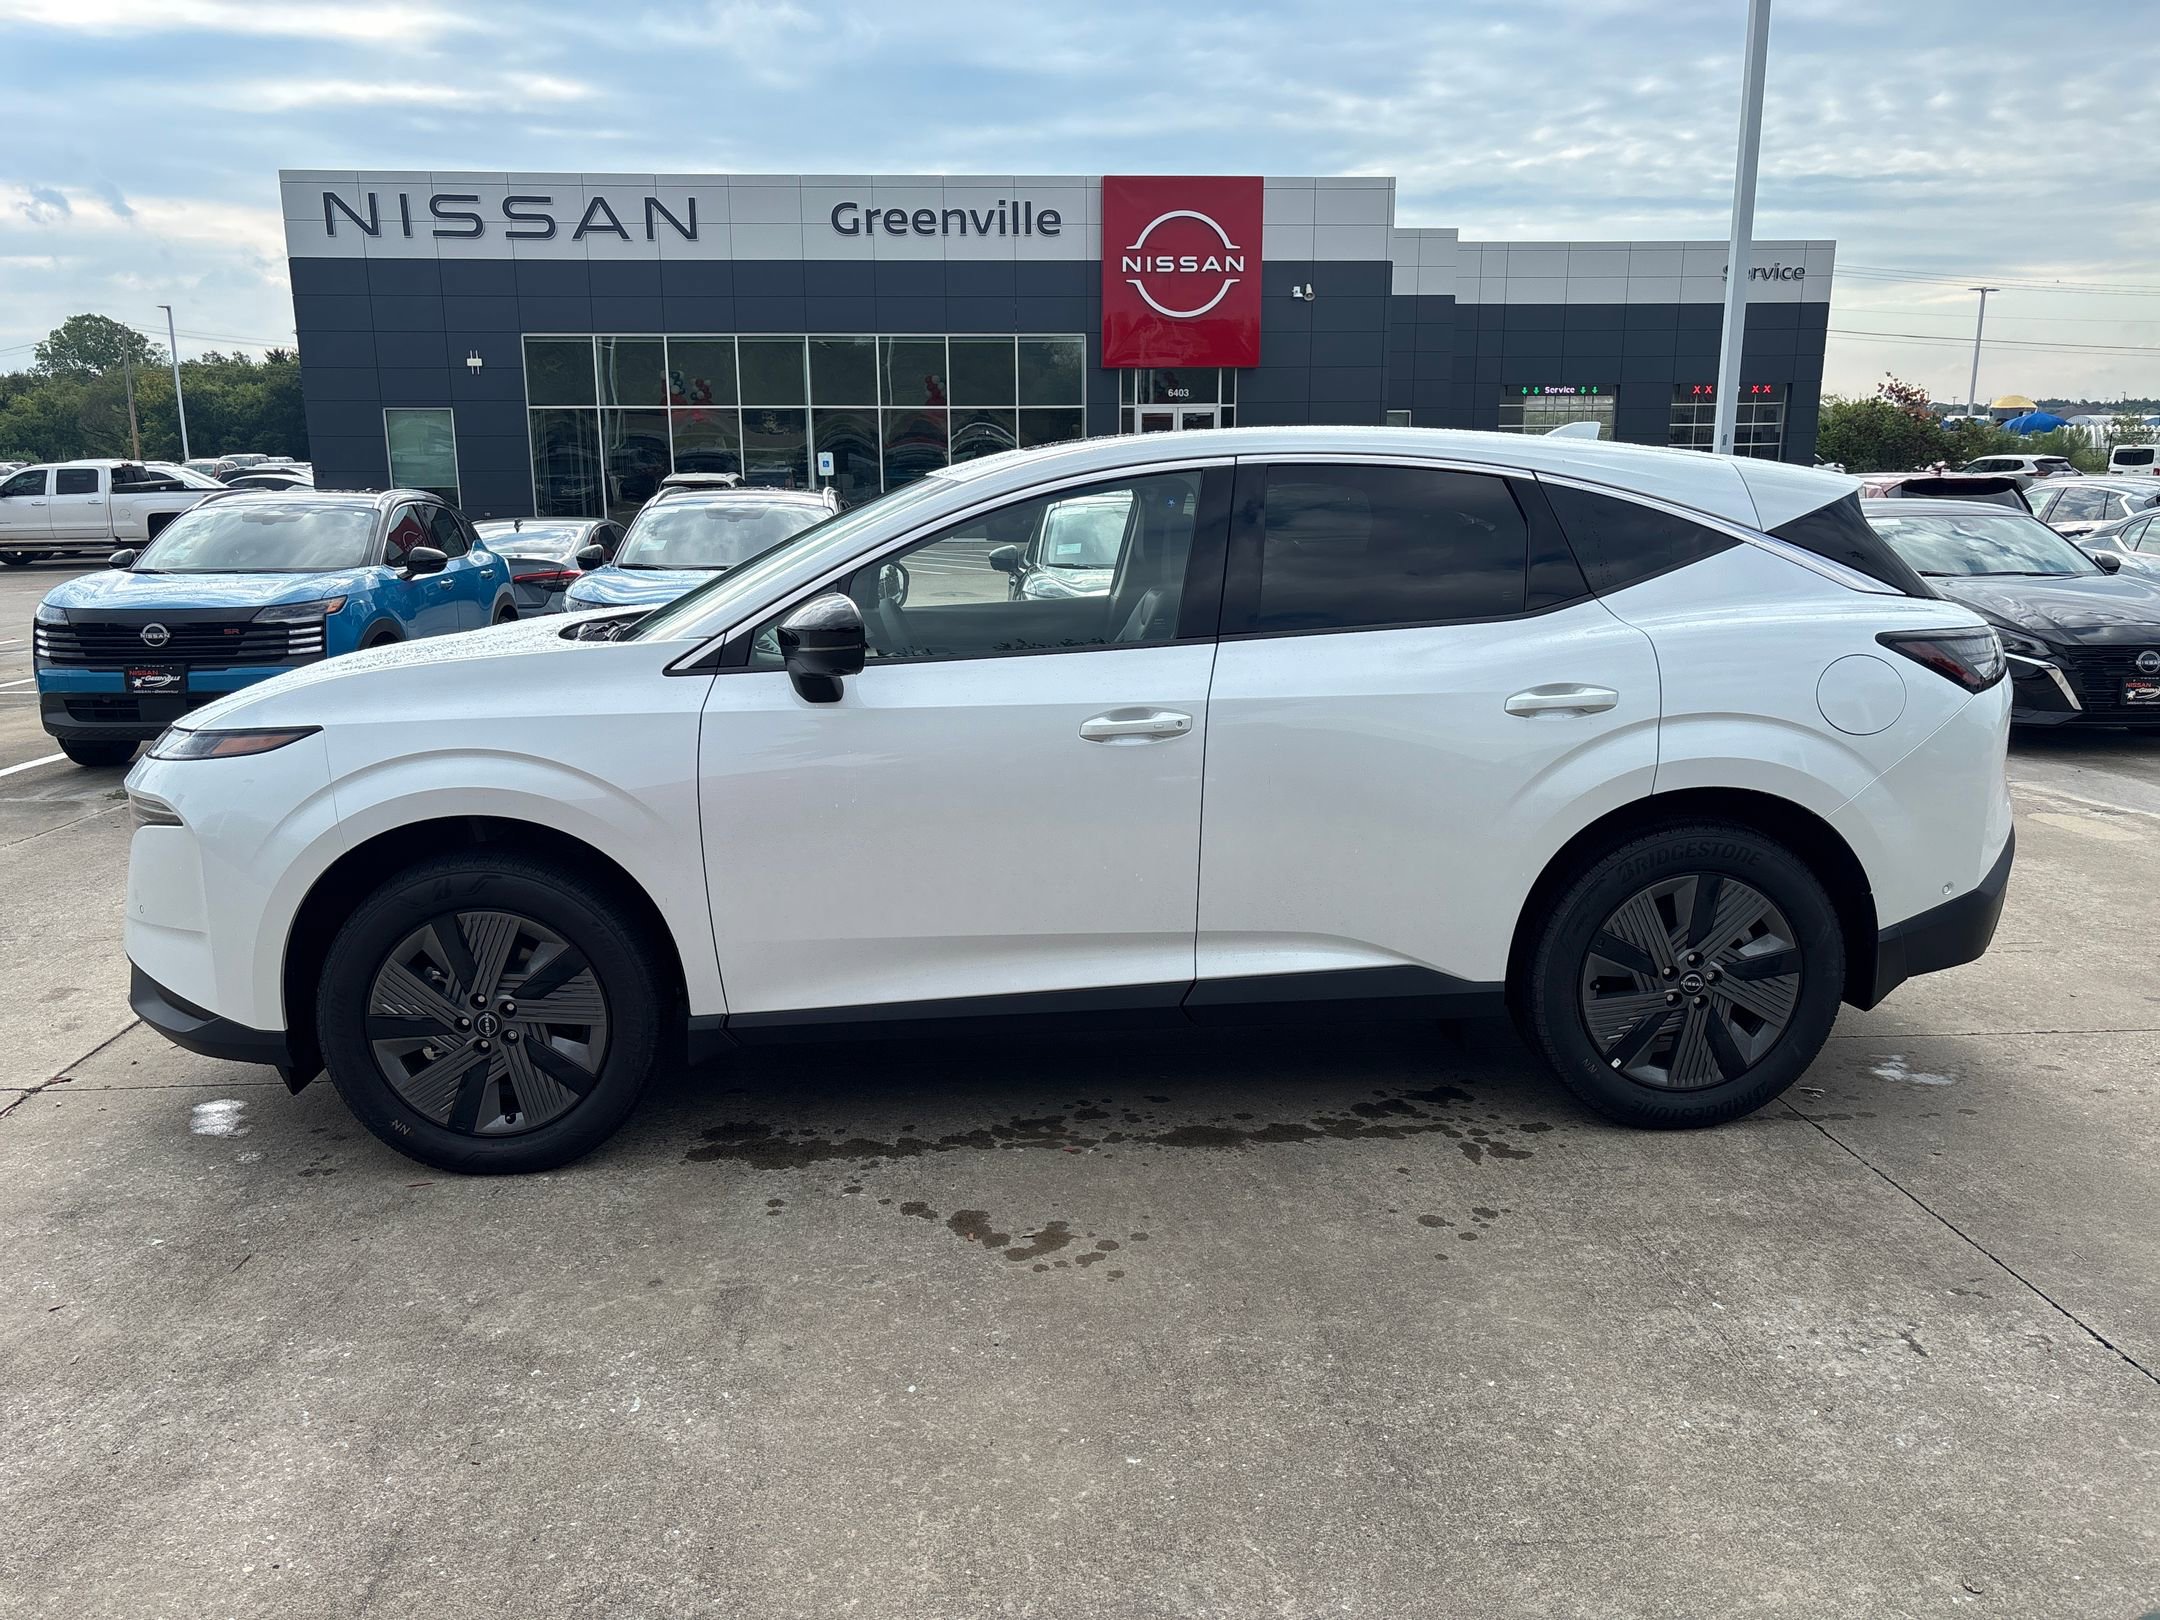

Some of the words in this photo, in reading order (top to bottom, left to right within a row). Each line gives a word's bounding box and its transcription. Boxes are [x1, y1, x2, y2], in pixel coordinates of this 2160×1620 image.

[322, 191, 699, 242] NISSAN
[830, 200, 1063, 236] Greenville
[1121, 255, 1245, 273] NISSAN
[1722, 262, 1806, 281] rvice
[1167, 388, 1190, 397] 6403
[1544, 386, 1576, 394] Service
[1616, 842, 1763, 882] BRIDGESTONE
